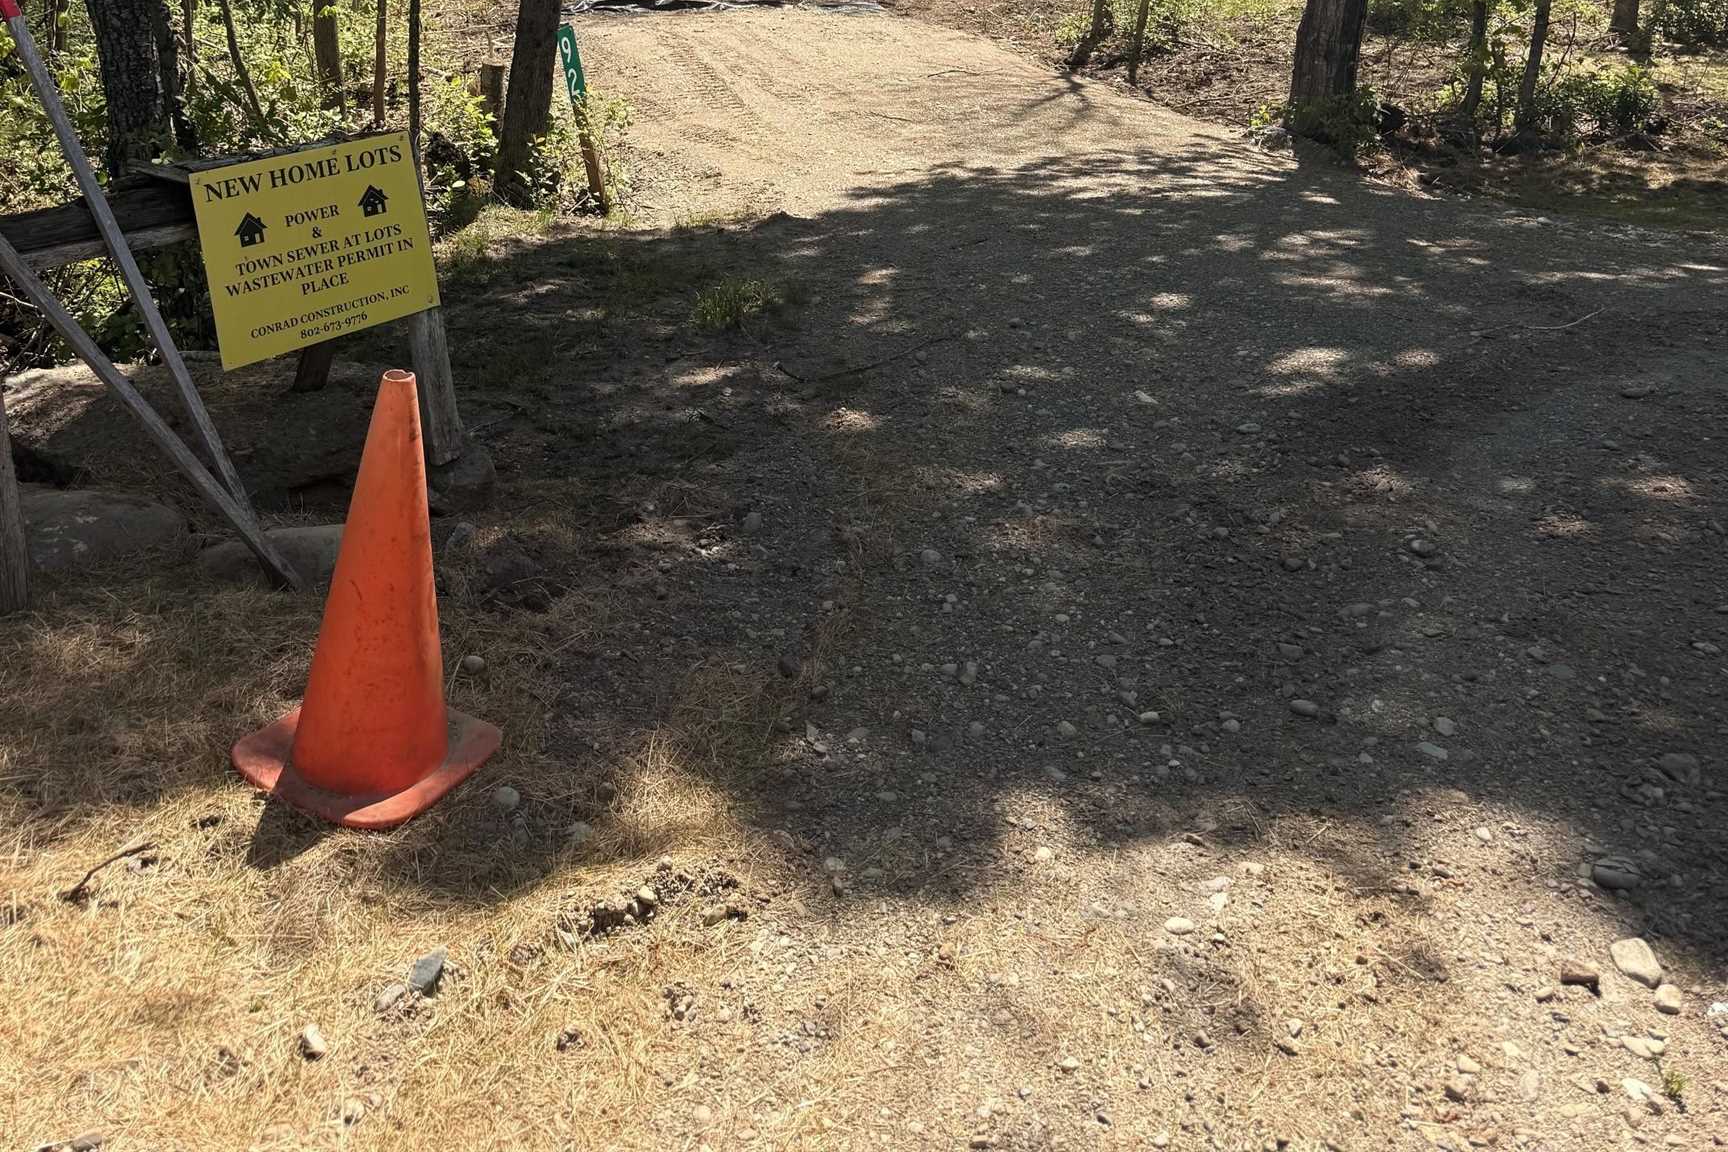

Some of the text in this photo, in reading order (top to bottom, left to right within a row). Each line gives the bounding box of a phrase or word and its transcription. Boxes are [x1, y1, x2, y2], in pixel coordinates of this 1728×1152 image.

[204, 145, 401, 202] NEW HOME LOTS
[285, 204, 339, 227] POWER
[312, 226, 322, 238] &
[226, 238, 413, 297] WASTEWATER PERMIT IN
[235, 224, 401, 276] TOWN SEWER AT LOTS
[301, 273, 349, 296] PLACE
[251, 285, 409, 338] CONRAD CONSTRUCTION, INC
[300, 312, 367, 339] 802-673-9776
